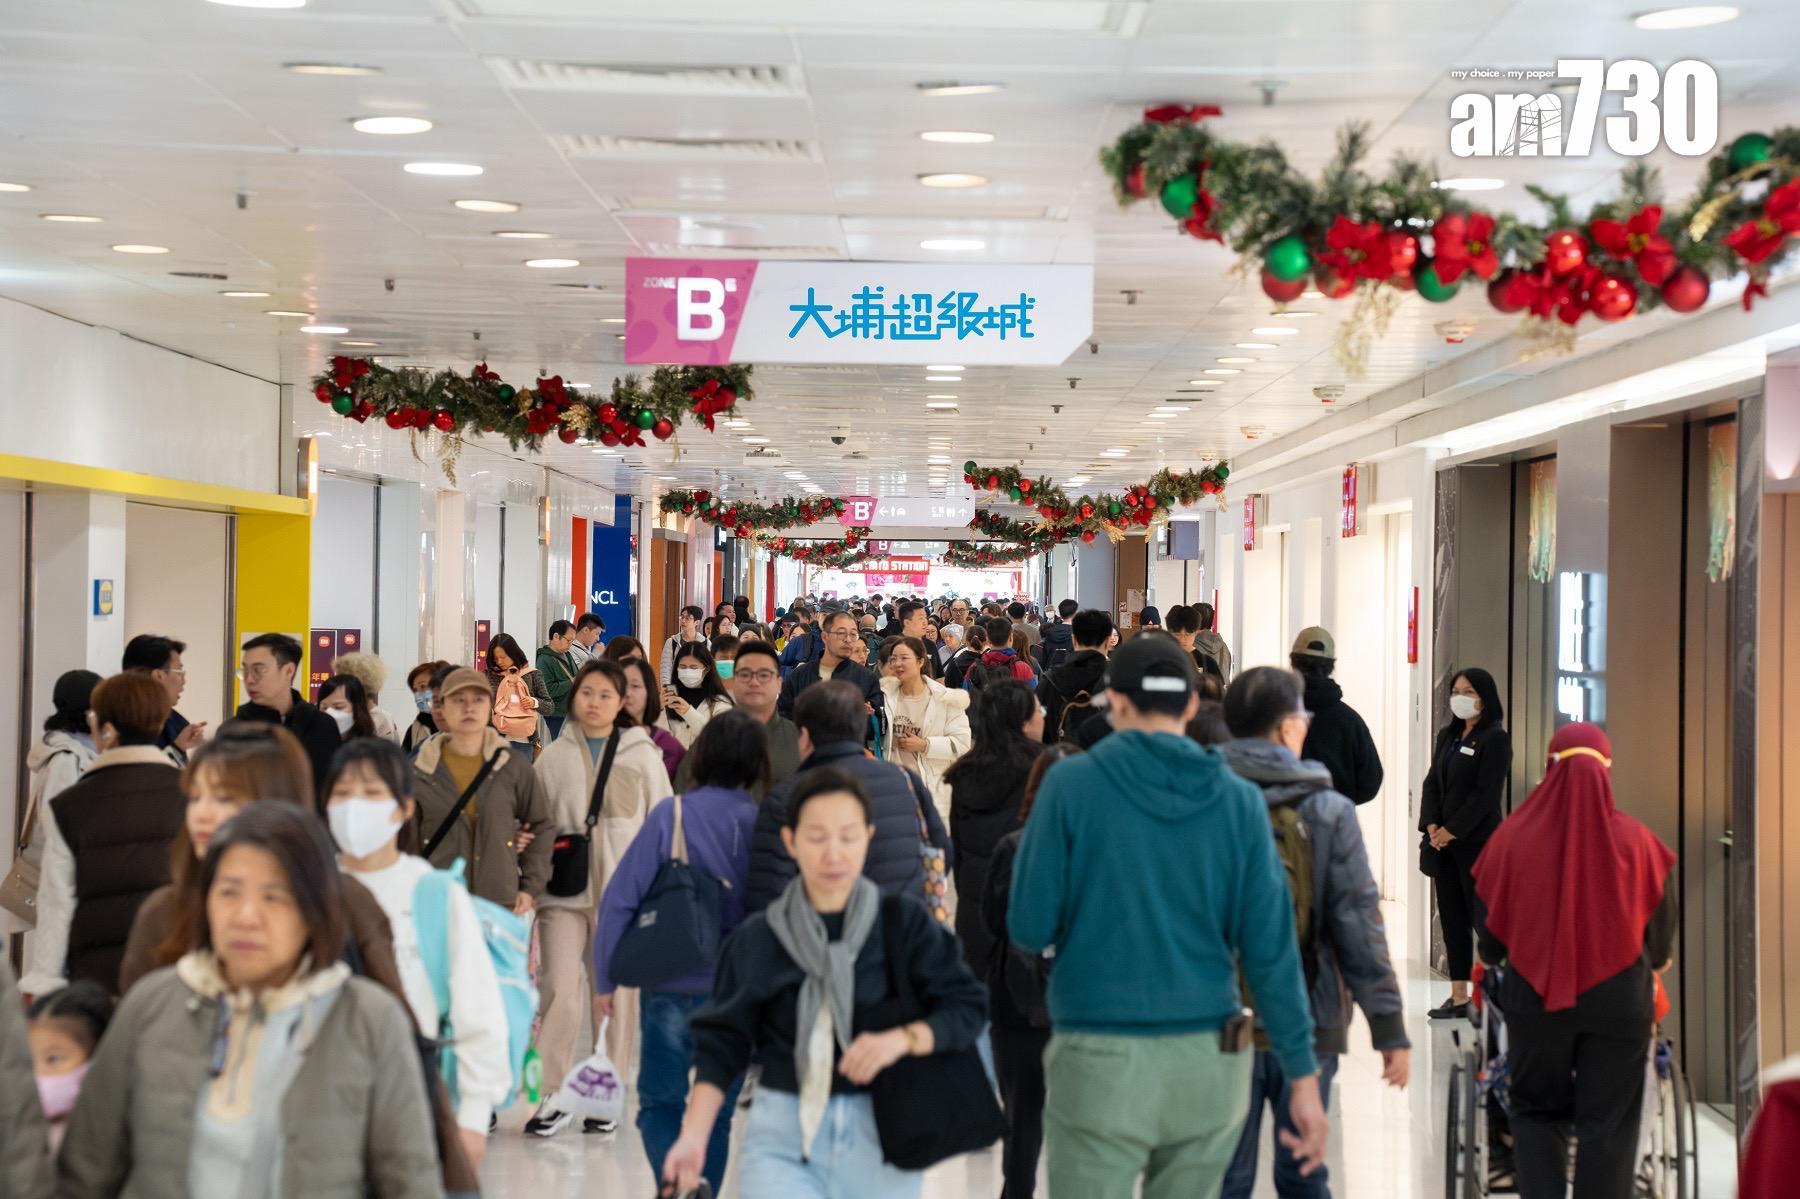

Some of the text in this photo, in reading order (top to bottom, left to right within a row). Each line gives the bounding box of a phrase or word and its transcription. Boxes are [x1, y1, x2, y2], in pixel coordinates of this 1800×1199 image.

[643, 277, 676, 289] ZONE
[677, 277, 726, 341] B
[788, 285, 1036, 341] 大埔超級城
[854, 501, 870, 521] B
[890, 560, 929, 571] STATION
[591, 590, 619, 605] NCL
